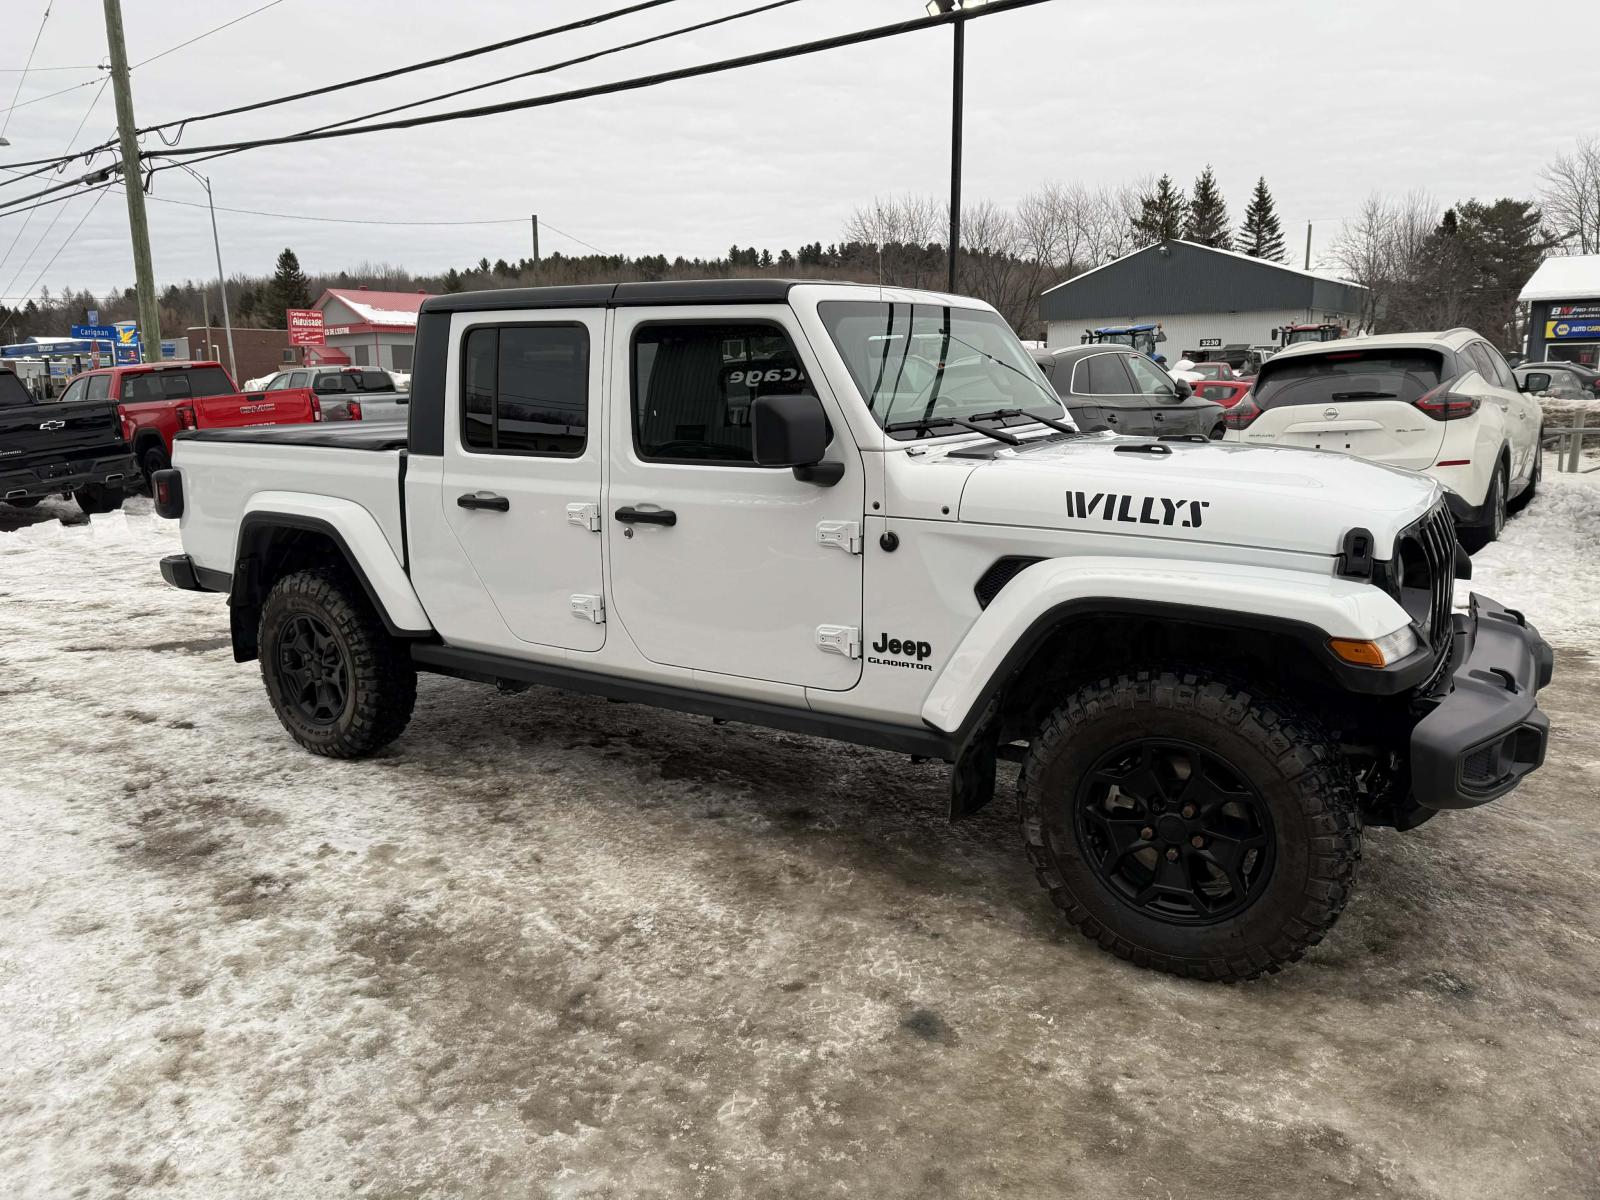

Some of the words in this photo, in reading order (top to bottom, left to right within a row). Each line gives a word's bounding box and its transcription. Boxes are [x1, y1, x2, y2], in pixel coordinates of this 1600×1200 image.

[81, 328, 109, 337] Carignan
[1065, 490, 1210, 529] WILLYS
[872, 632, 932, 661] Jeep
[867, 657, 933, 671] GLADIATOR
